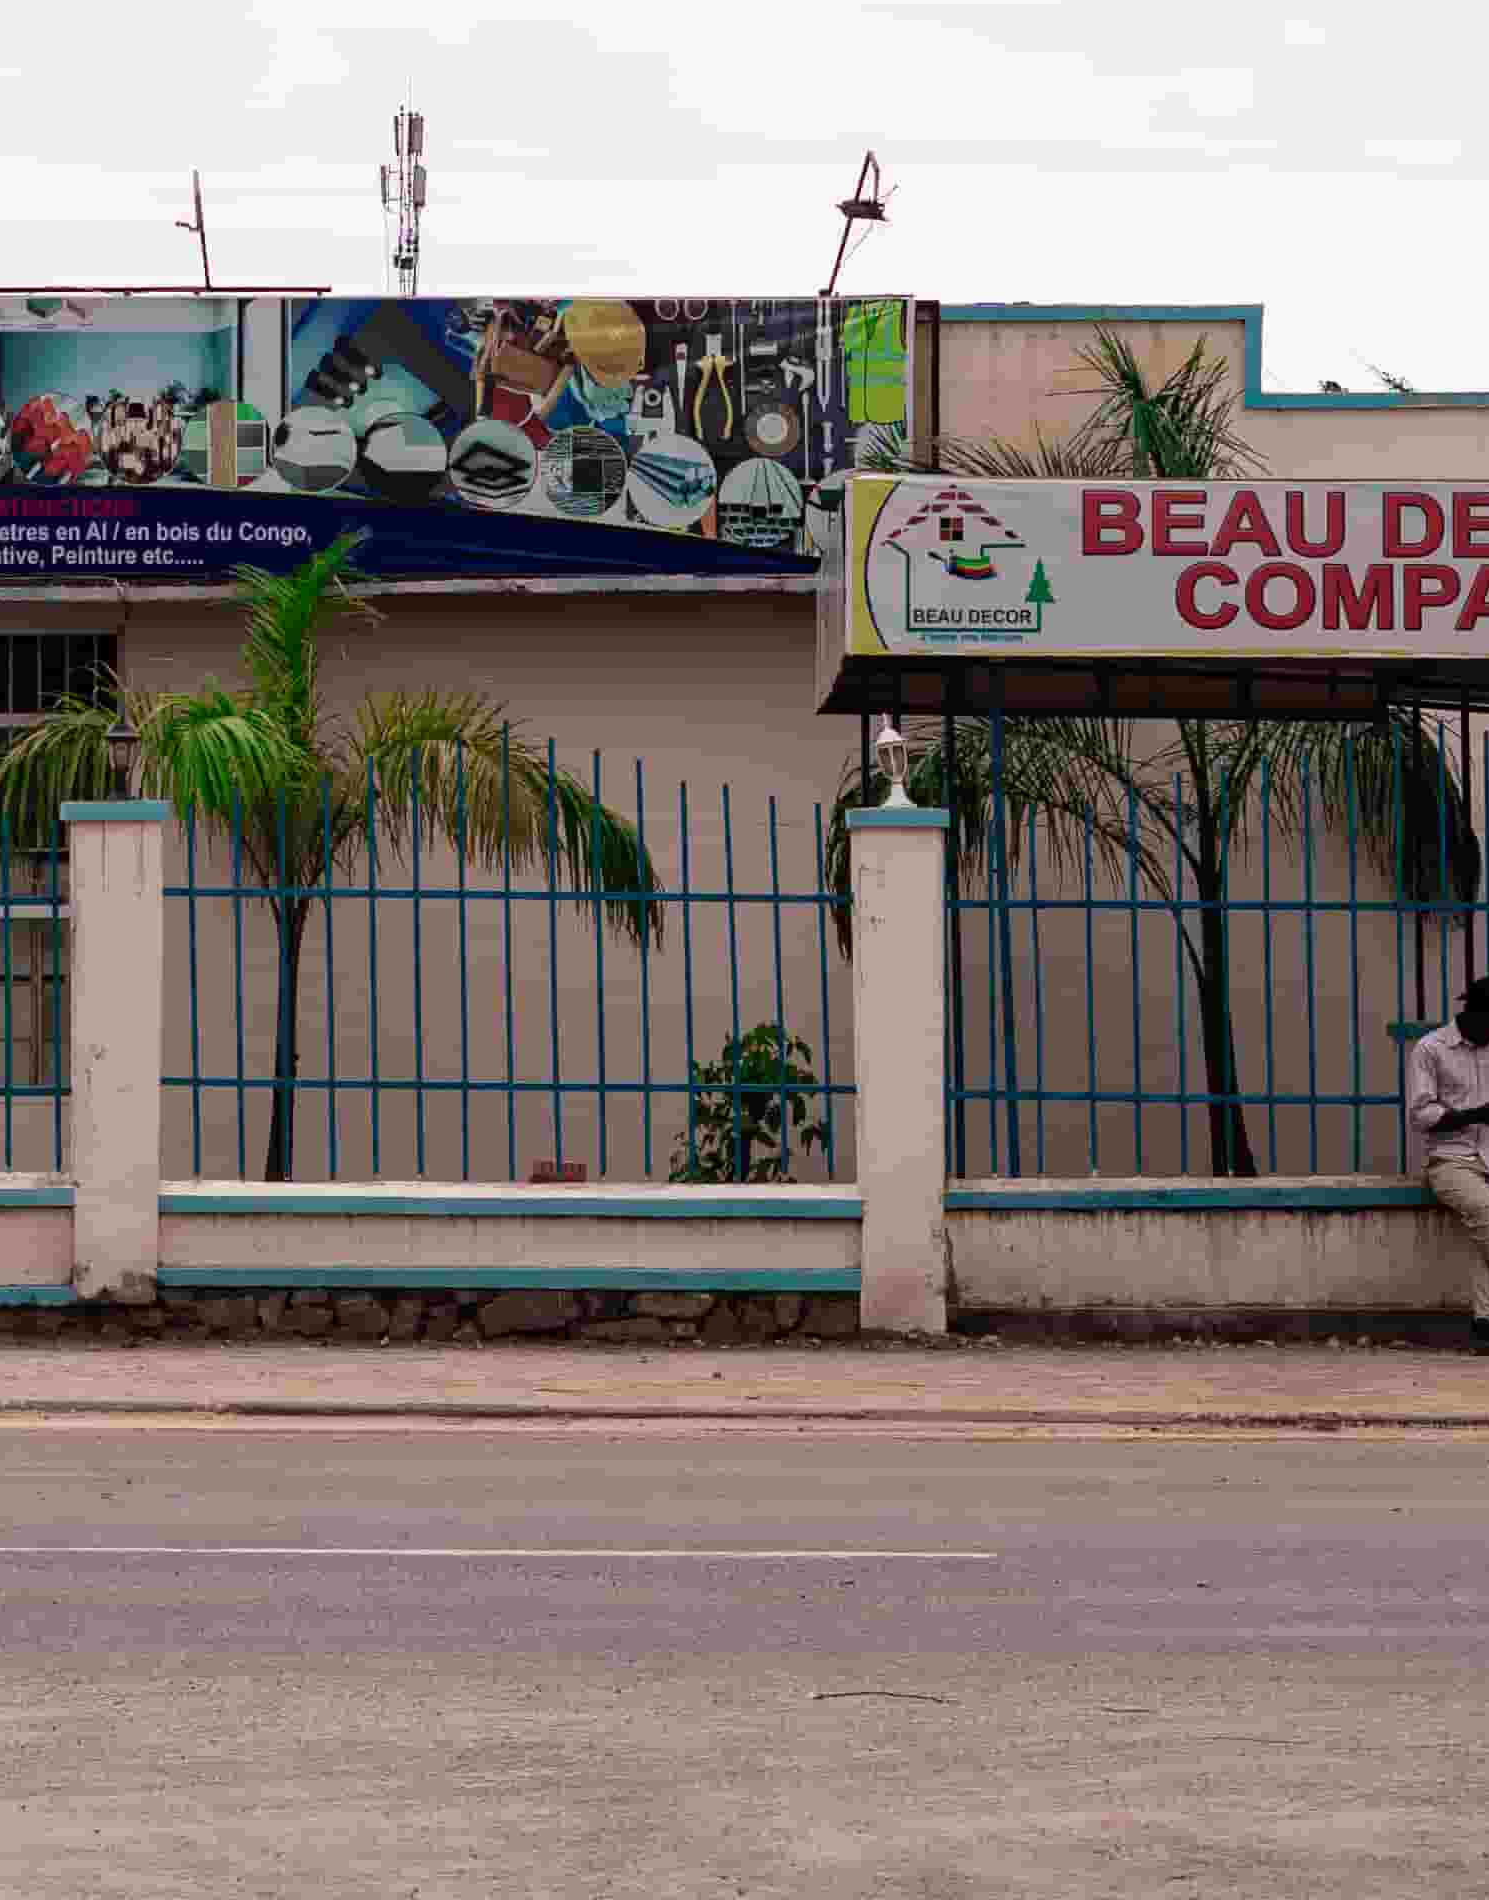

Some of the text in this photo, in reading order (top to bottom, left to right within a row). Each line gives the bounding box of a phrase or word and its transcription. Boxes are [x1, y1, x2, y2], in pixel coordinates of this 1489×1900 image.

[55, 524, 81, 541] en
[124, 524, 150, 541] en
[156, 521, 201, 541] bois
[206, 521, 233, 541] du
[238, 521, 313, 546] Congo,
[1081, 488, 1347, 558] BEAU
[52, 545, 137, 565] Peinture
[913, 608, 1032, 624] BEAU DECOR
